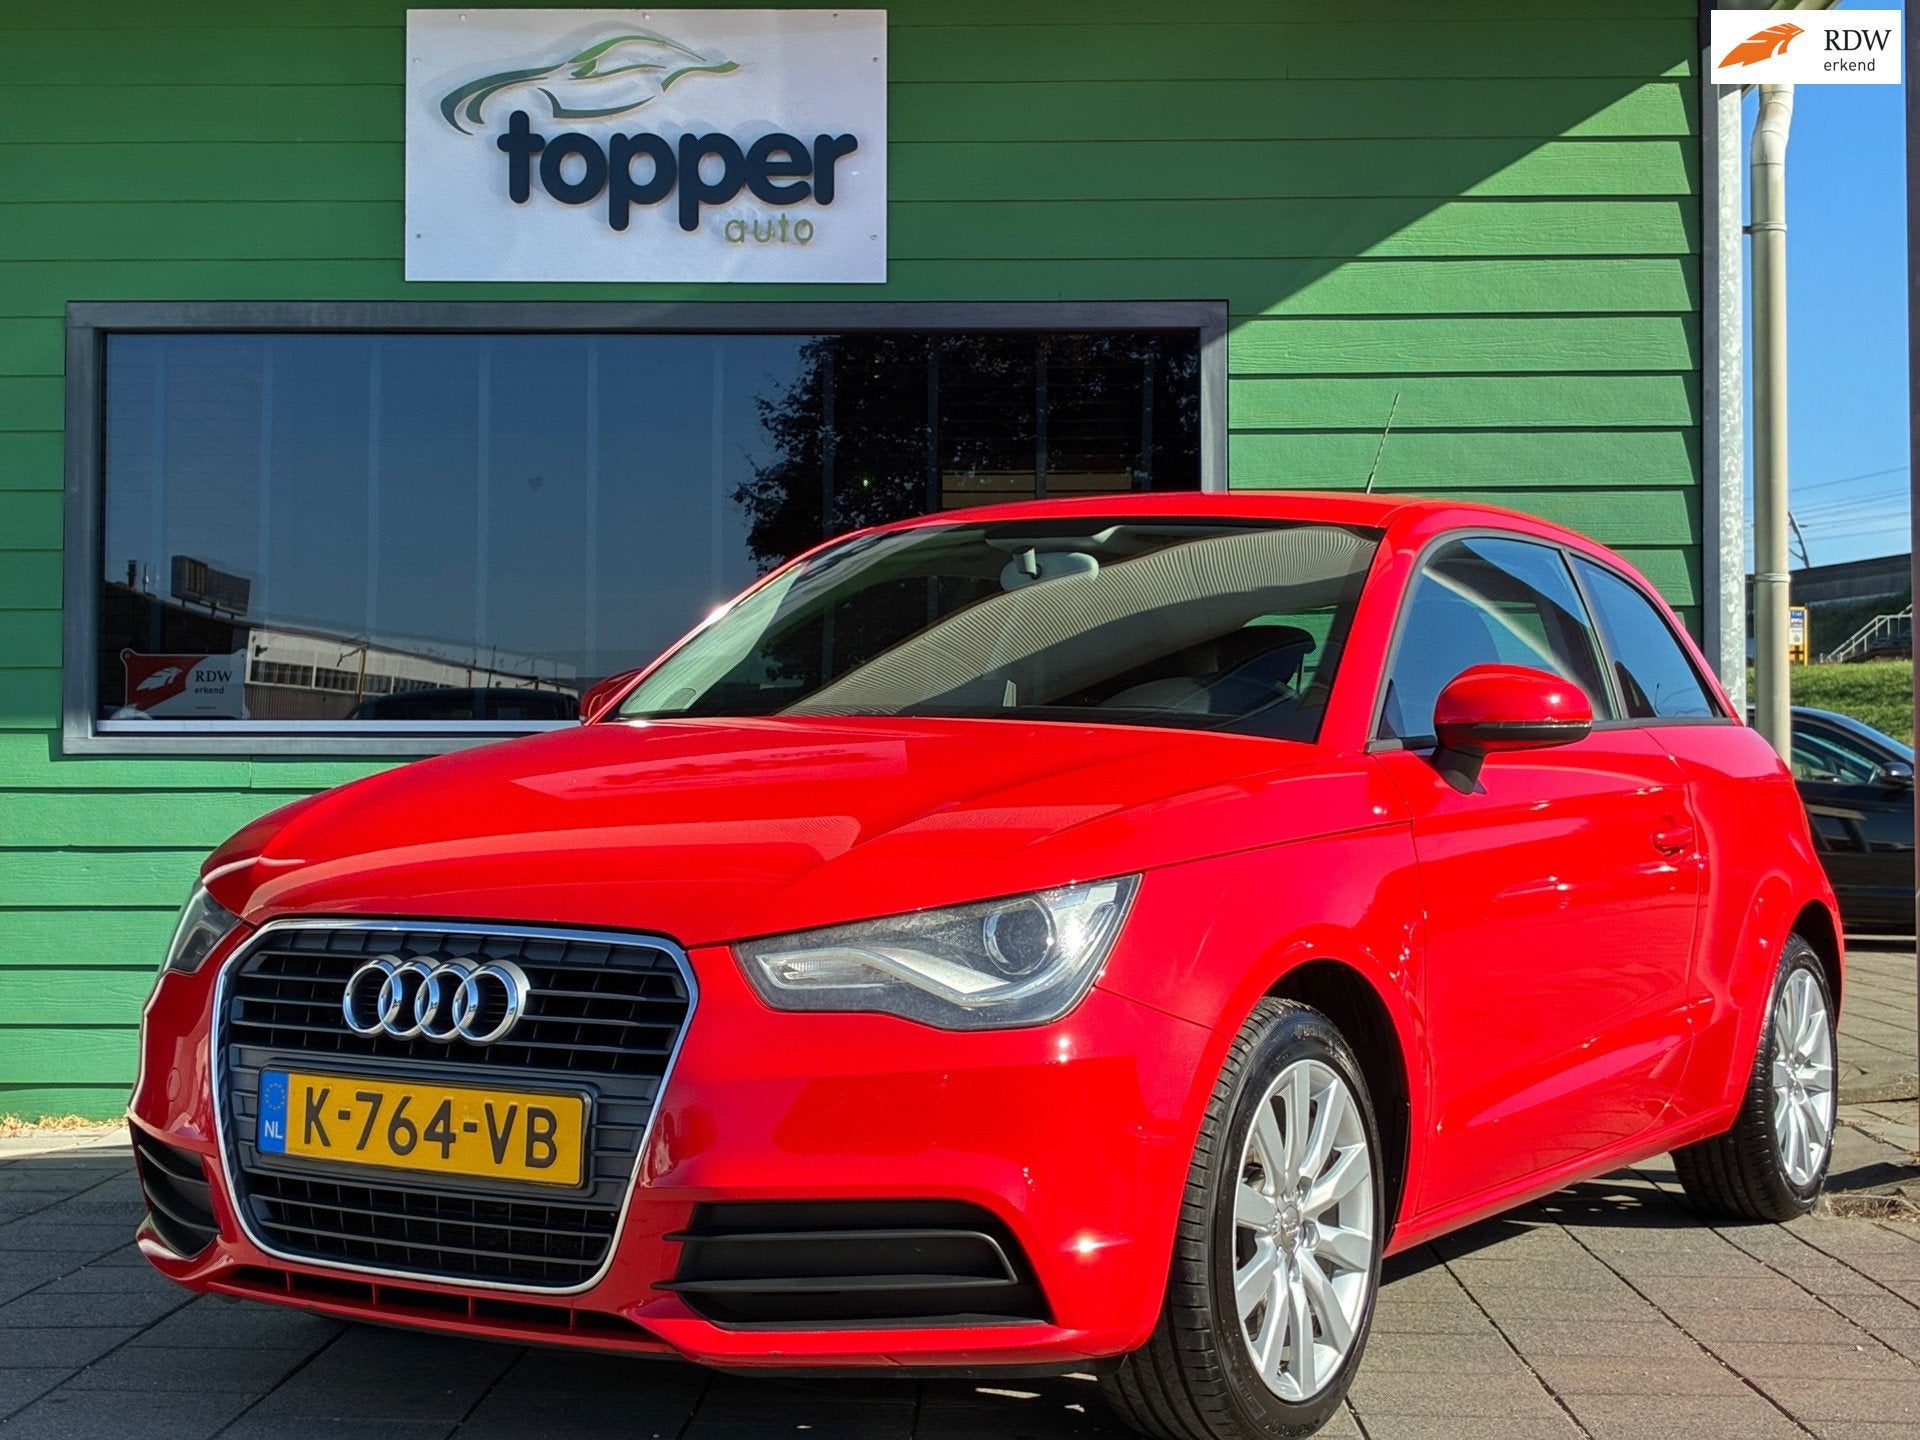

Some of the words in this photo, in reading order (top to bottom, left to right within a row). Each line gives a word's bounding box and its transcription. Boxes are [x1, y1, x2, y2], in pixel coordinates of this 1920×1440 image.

[497, 110, 858, 231] topper
[724, 213, 814, 243] auto
[195, 670, 233, 682] RDW
[194, 685, 225, 694] erkend
[264, 1120, 283, 1139] NL
[303, 1086, 557, 1169] K-764-VB
